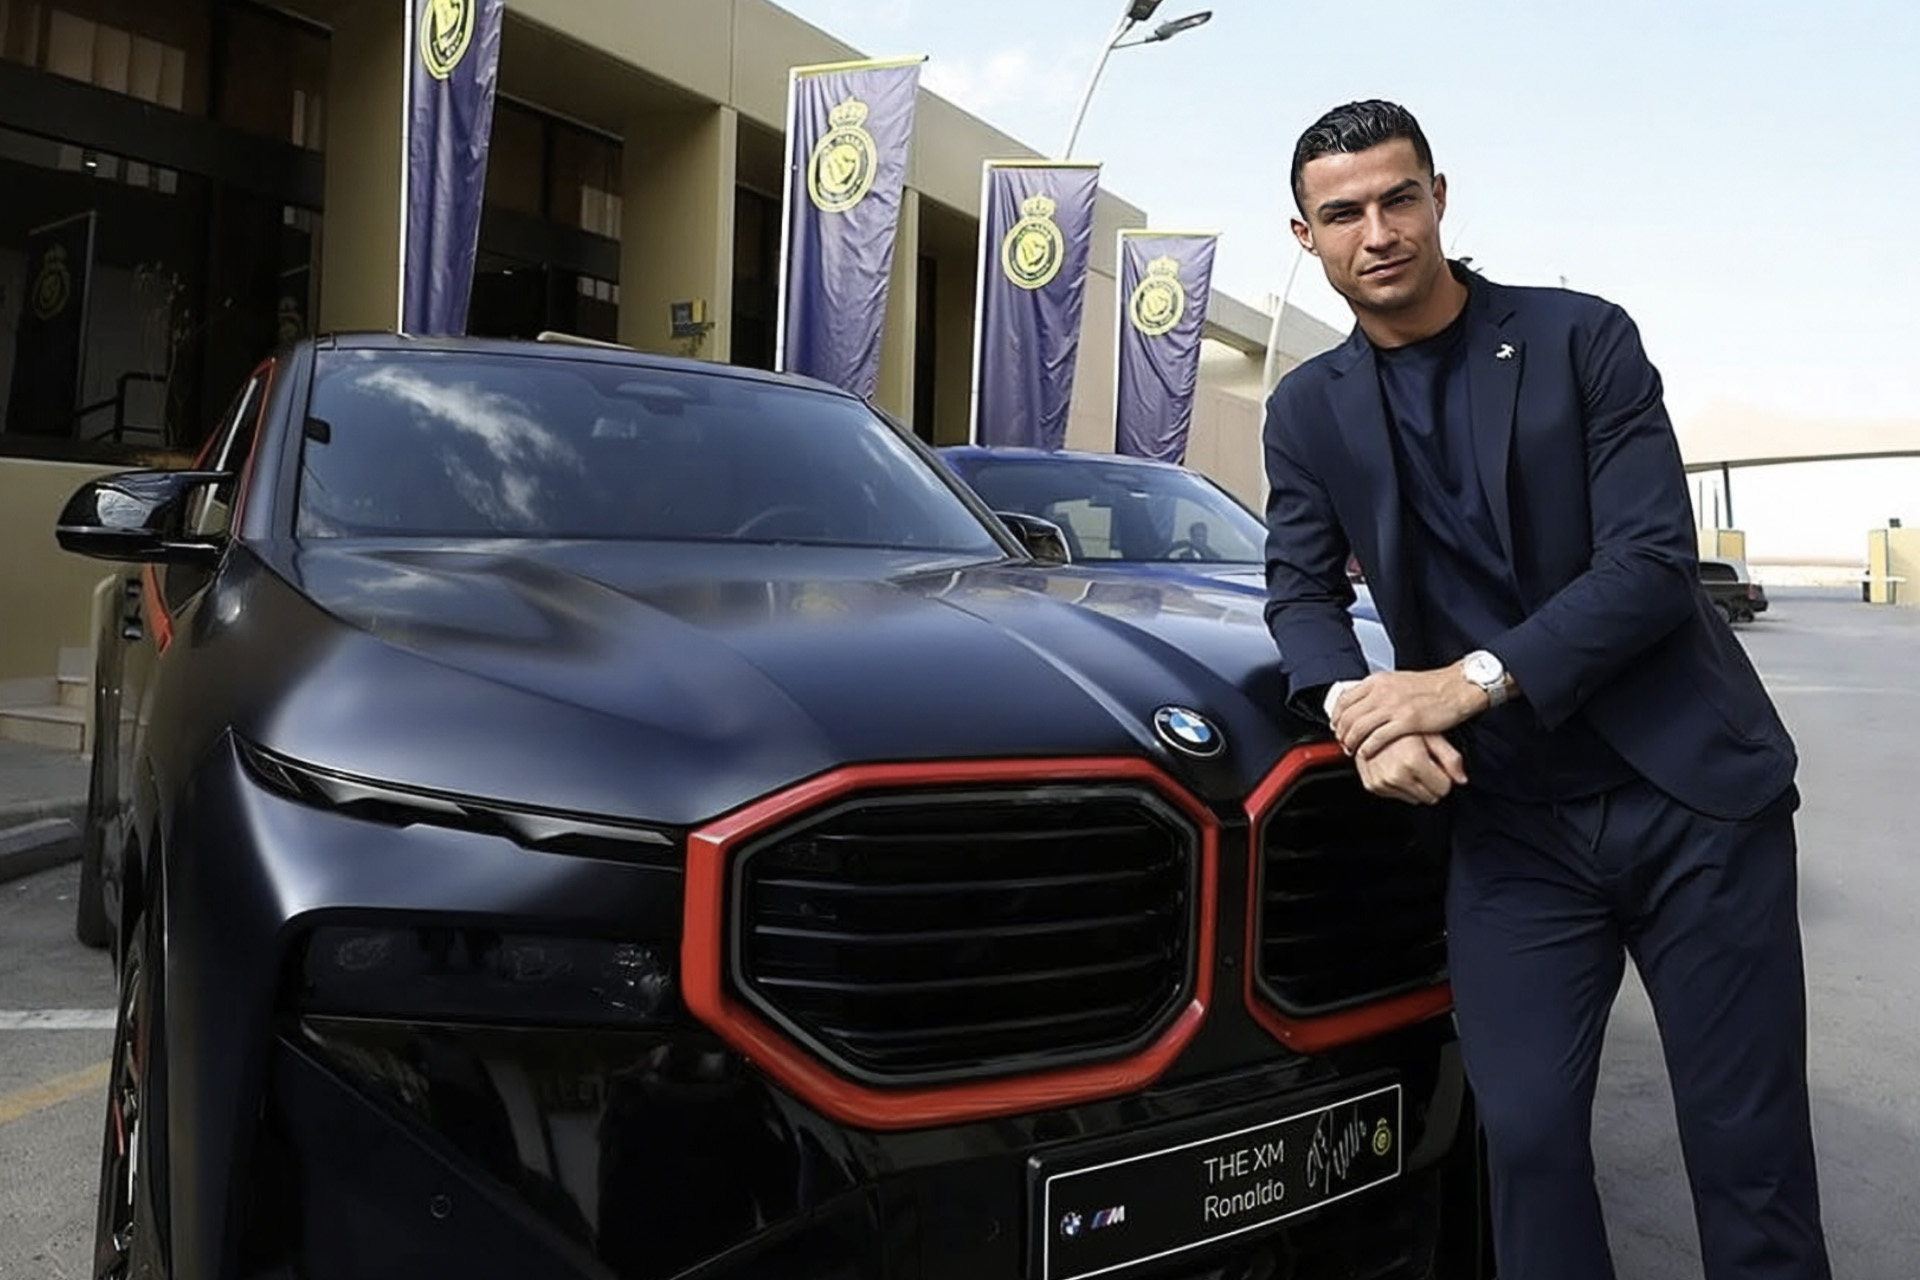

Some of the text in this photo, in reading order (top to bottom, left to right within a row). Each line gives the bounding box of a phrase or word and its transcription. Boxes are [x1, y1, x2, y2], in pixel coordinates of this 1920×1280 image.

[1203, 1139, 1284, 1184] THE XM
[1204, 1179, 1285, 1221] Ronaldo
